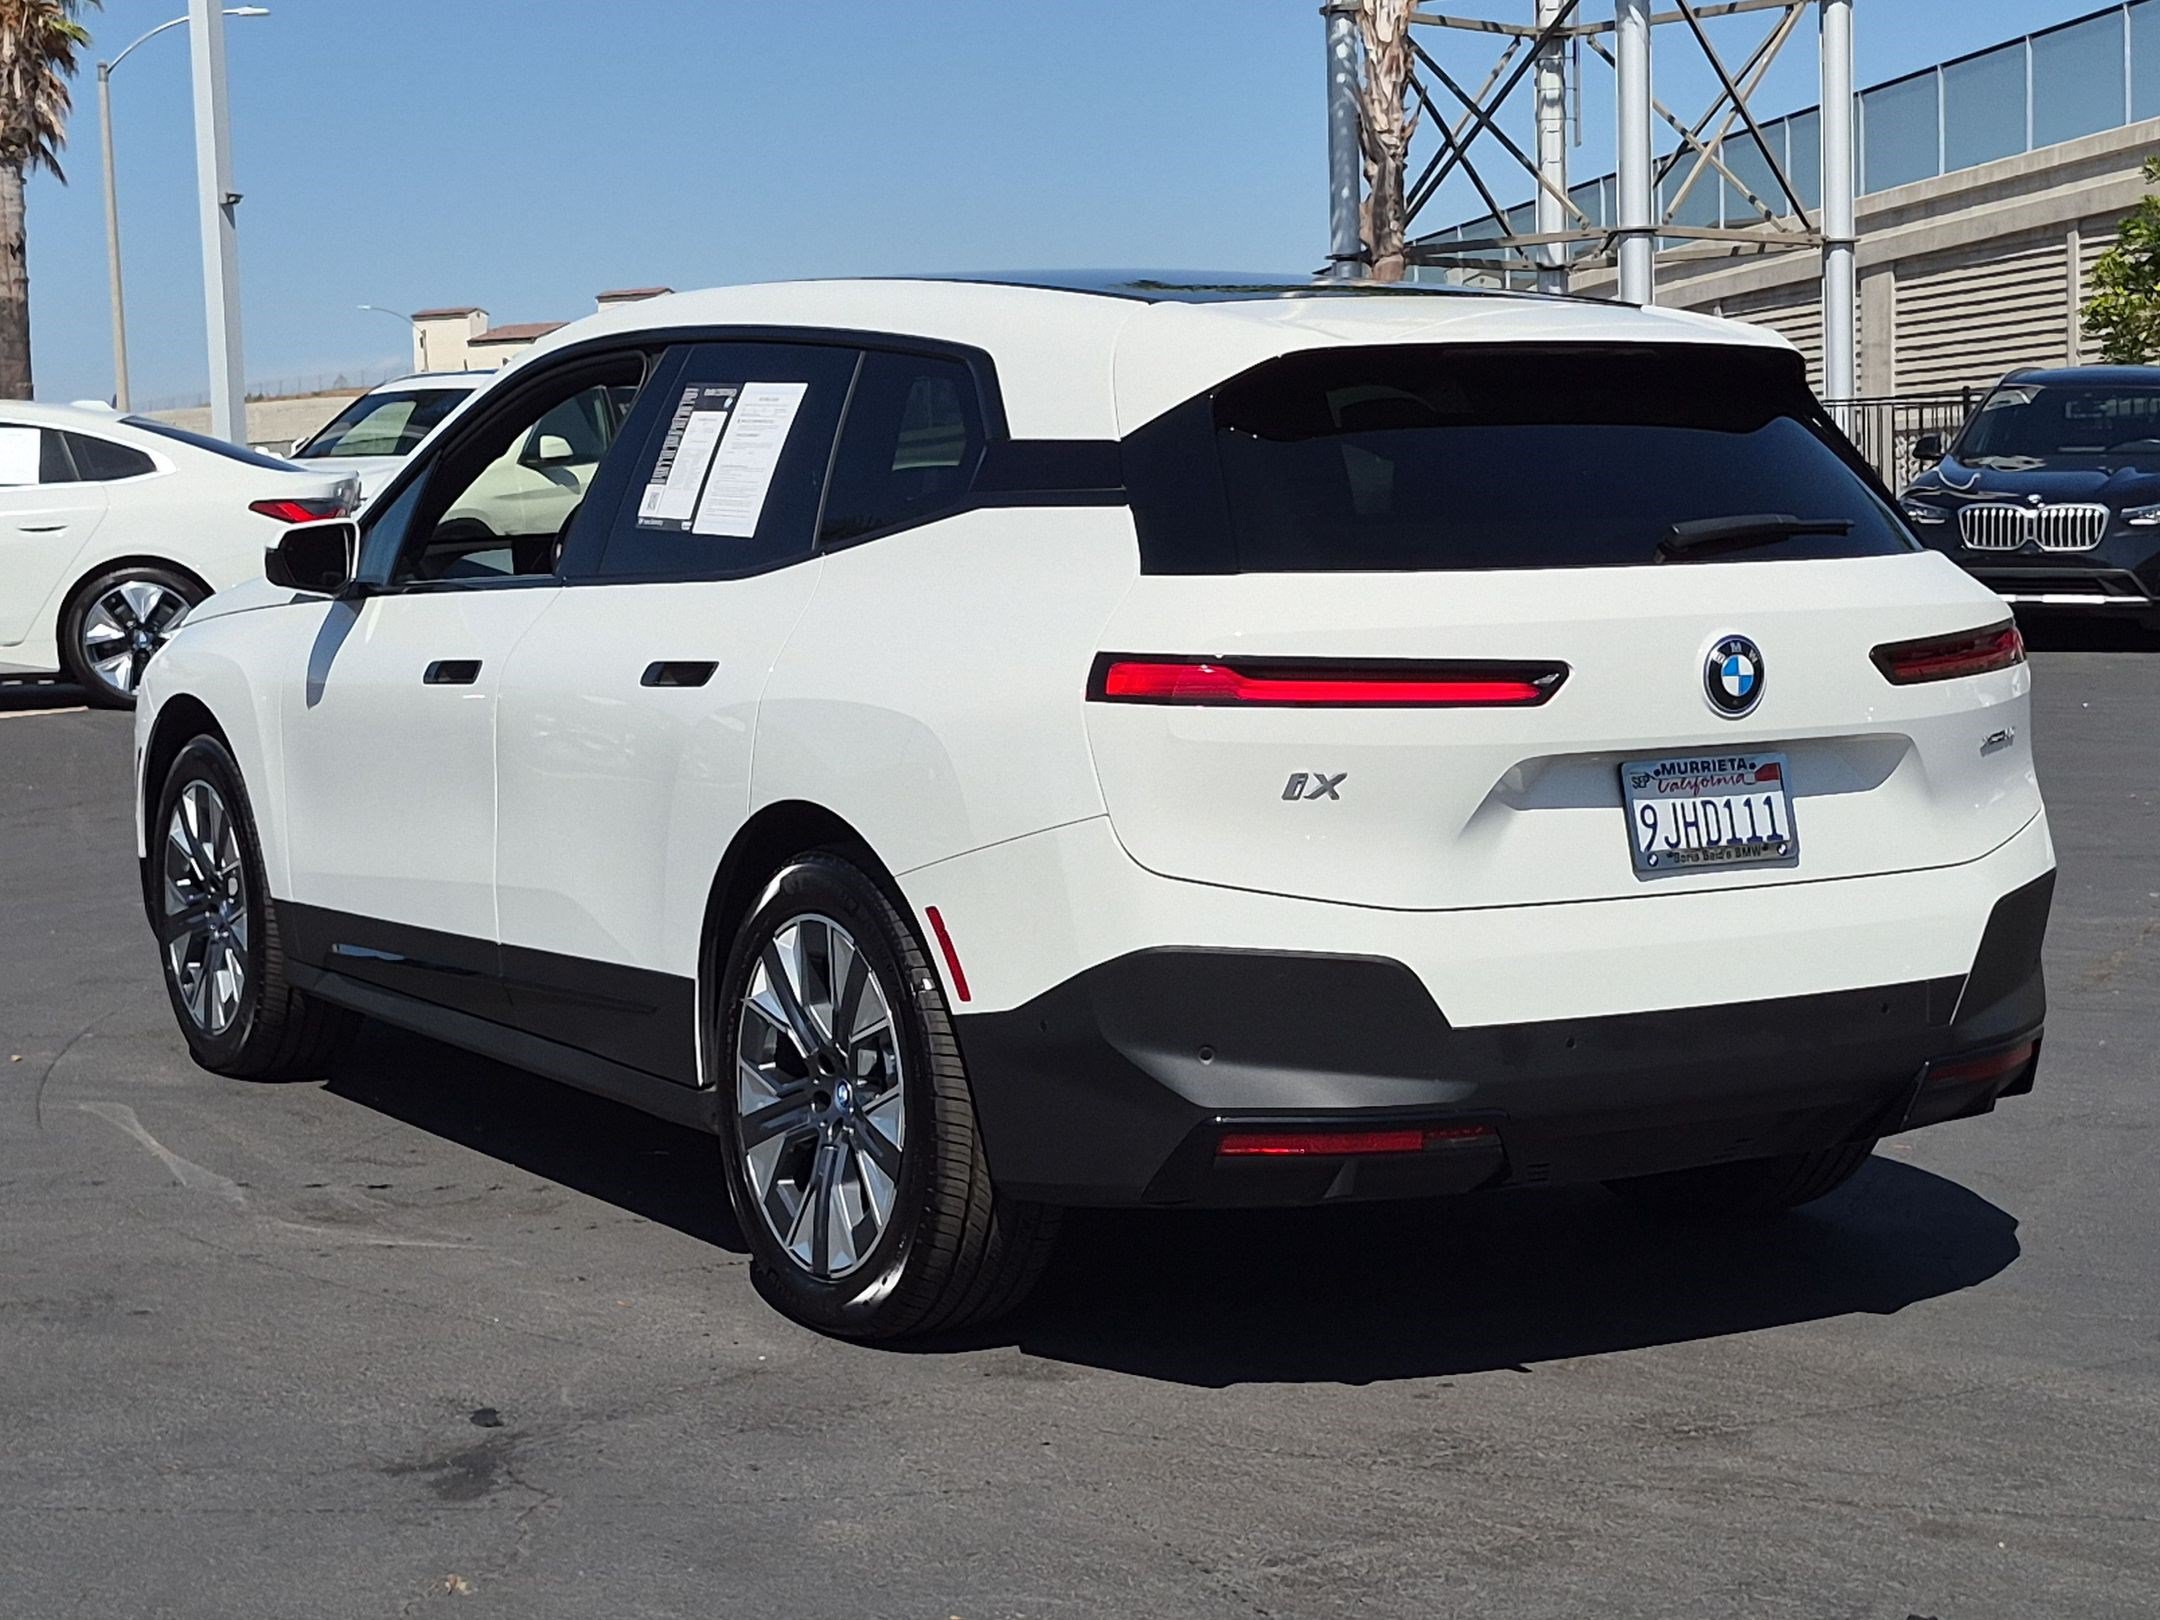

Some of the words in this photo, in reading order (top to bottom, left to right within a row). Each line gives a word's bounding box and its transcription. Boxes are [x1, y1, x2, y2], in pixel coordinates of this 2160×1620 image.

[1710, 642, 1757, 664] BMW
[1662, 758, 1747, 776] MURRIETA
[1658, 773, 1746, 797] California
[1640, 796, 1783, 852] 9JHD111
[1735, 846, 1761, 858] BMW
